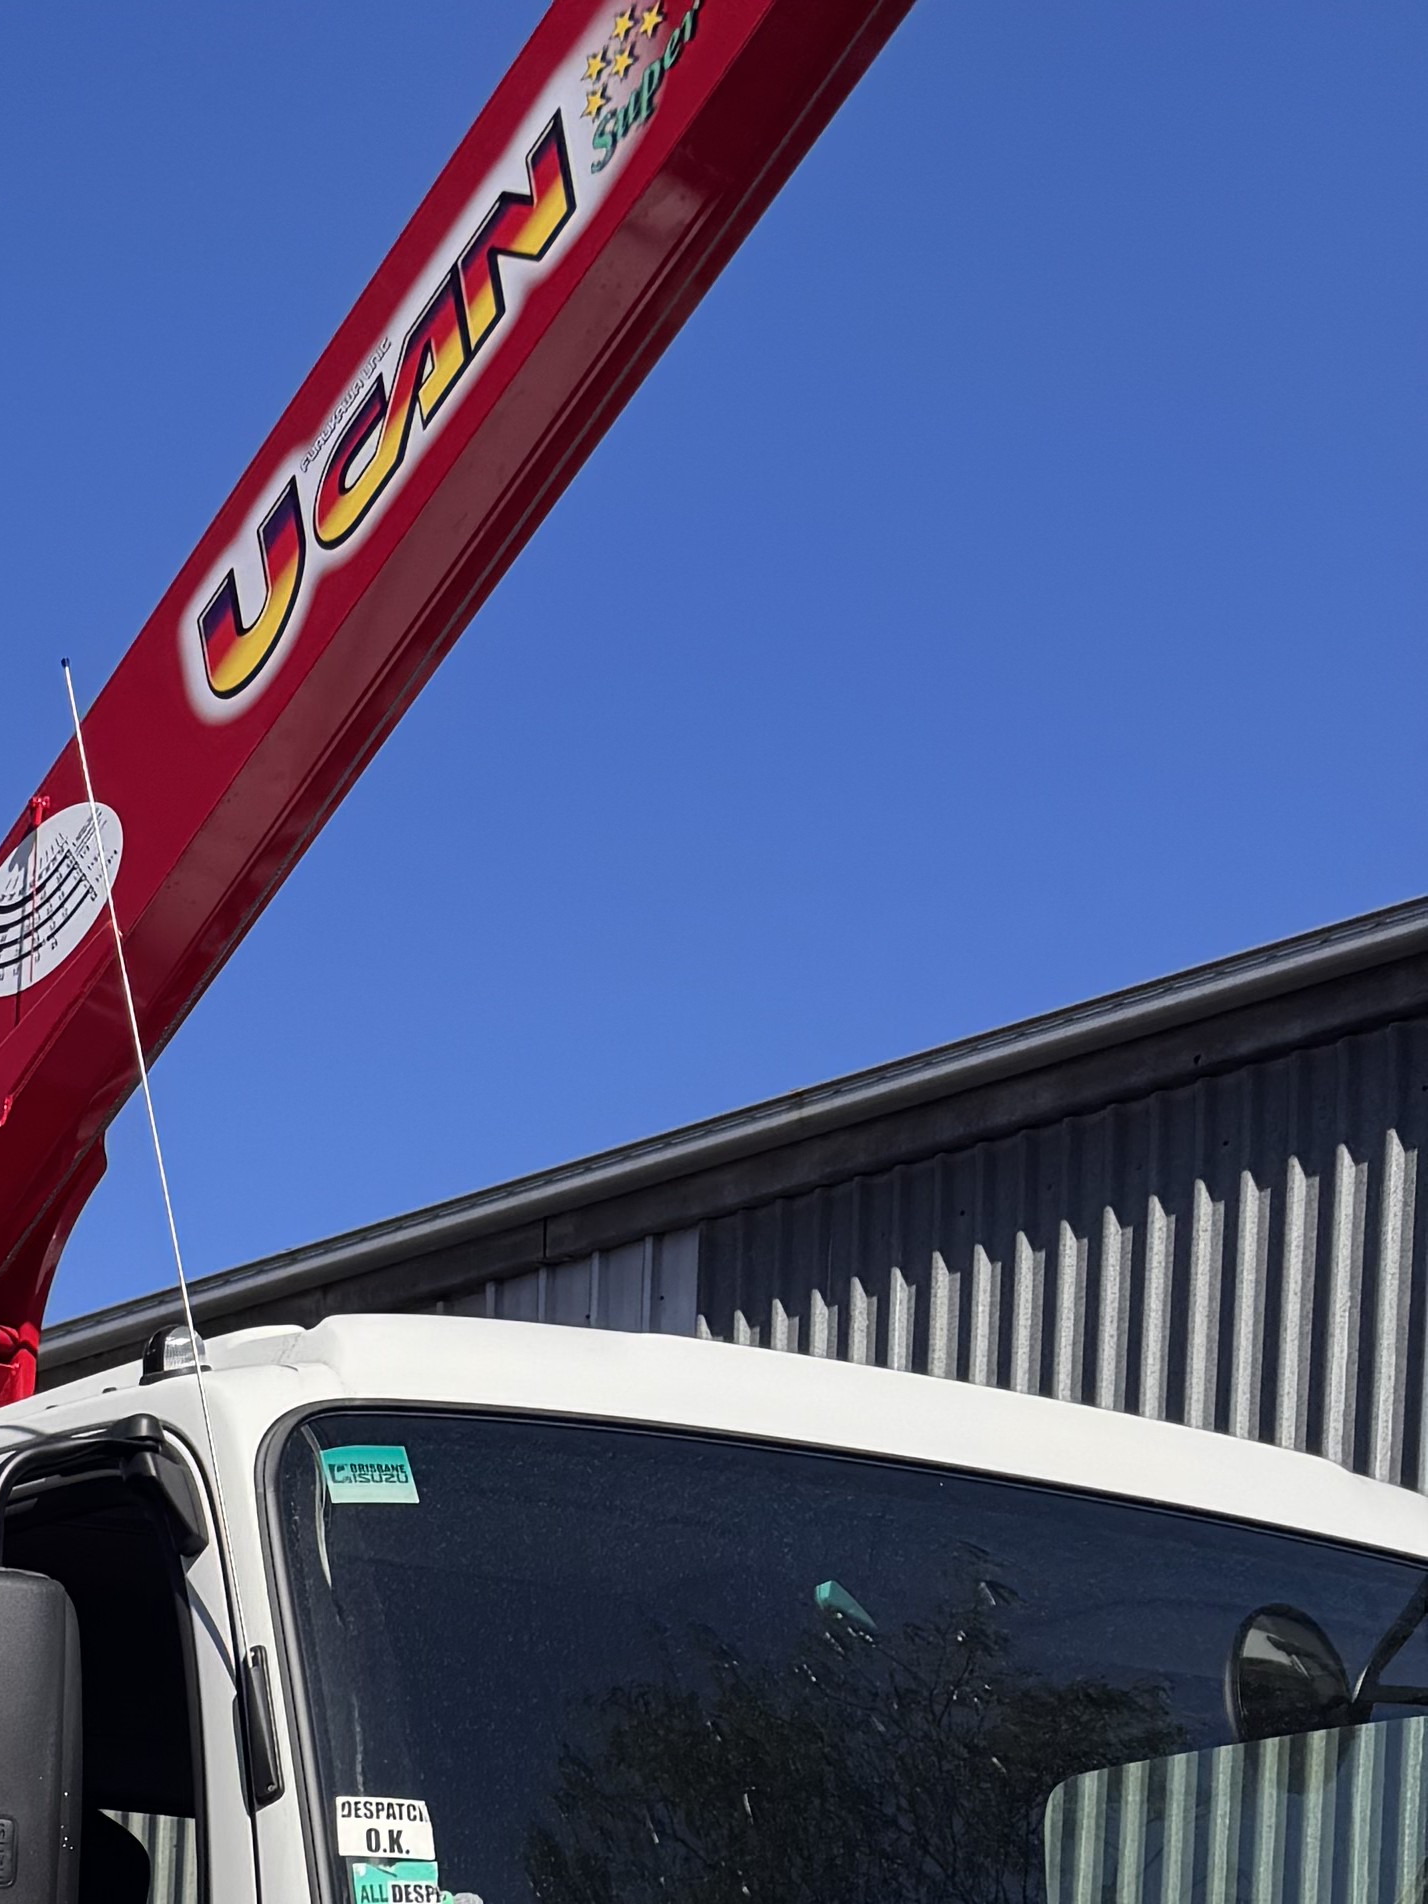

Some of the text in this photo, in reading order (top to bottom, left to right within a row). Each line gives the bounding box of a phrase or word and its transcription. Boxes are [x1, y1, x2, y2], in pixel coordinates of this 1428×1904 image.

[590, 0, 701, 175] Super
[300, 337, 392, 474] FURUKAWA UNIC
[349, 1463, 407, 1474] BRISBANE
[352, 1473, 409, 1484] ISUZU
[365, 1827, 411, 1855] O.K.
